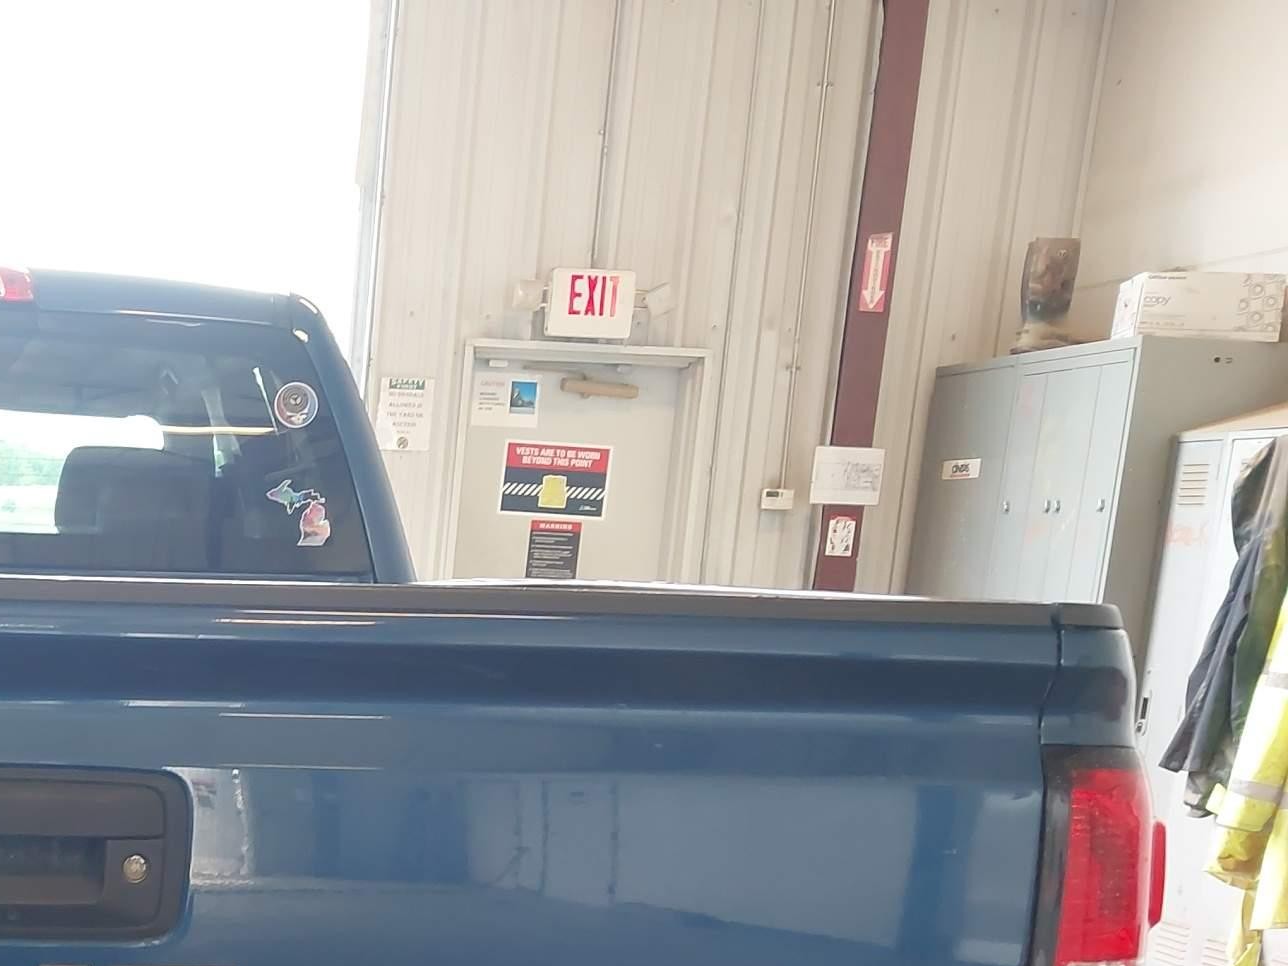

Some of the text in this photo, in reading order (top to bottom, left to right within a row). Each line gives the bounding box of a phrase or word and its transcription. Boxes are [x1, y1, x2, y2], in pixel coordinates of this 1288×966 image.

[568, 275, 620, 317] EXIT
[1143, 296, 1172, 306] copy
[516, 446, 601, 460] VESTS ARE TO BE WORN
[522, 456, 593, 468] BEYOND THIS POINT
